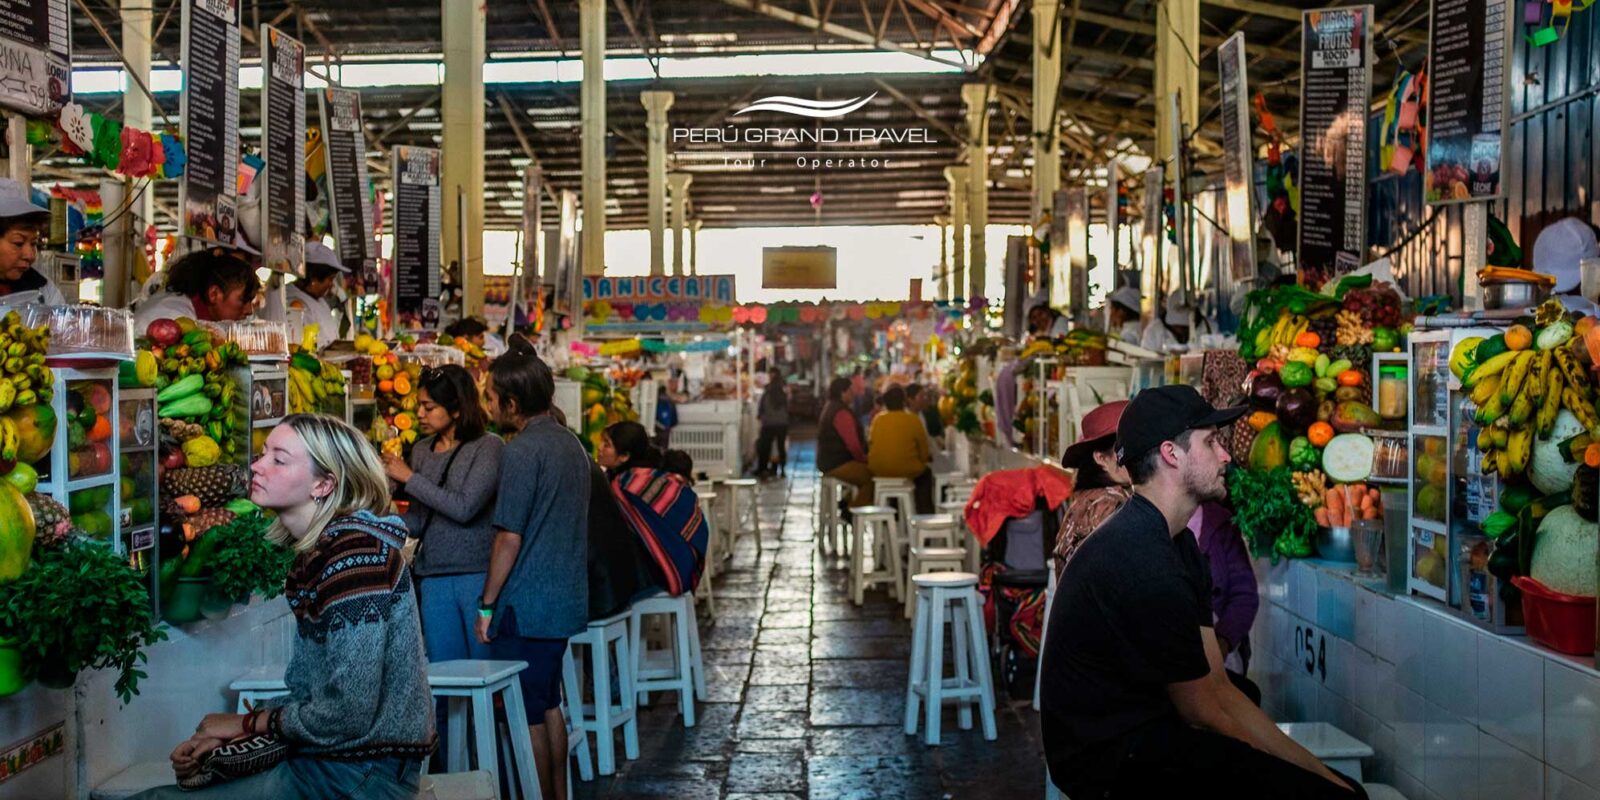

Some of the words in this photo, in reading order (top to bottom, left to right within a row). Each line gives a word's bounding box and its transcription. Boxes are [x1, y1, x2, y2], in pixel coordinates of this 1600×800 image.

[1319, 33, 1352, 49] FRUTAS
[583, 277, 732, 302] ARNICERIA
[1295, 625, 1327, 683] 054
